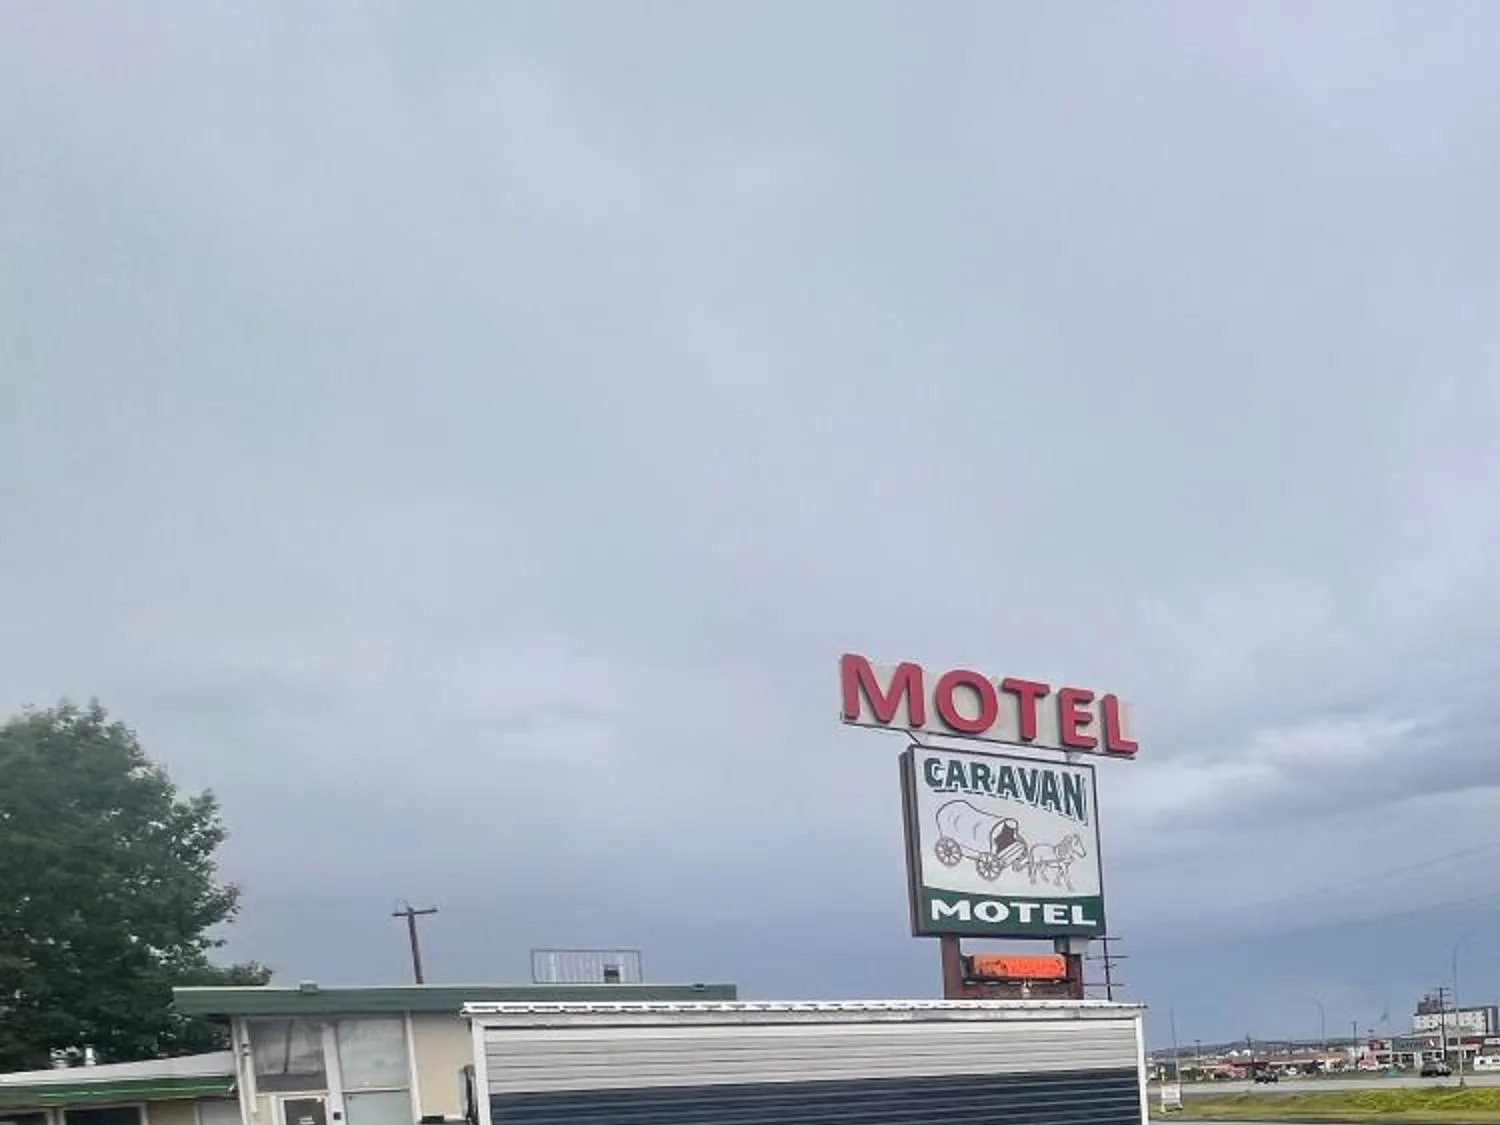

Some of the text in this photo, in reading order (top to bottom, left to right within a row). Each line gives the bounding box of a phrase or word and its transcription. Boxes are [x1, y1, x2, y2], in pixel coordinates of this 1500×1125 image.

[841, 653, 1138, 755] MOTEL
[923, 757, 1087, 824] CARAVAN
[931, 899, 1097, 926] MOTEL
